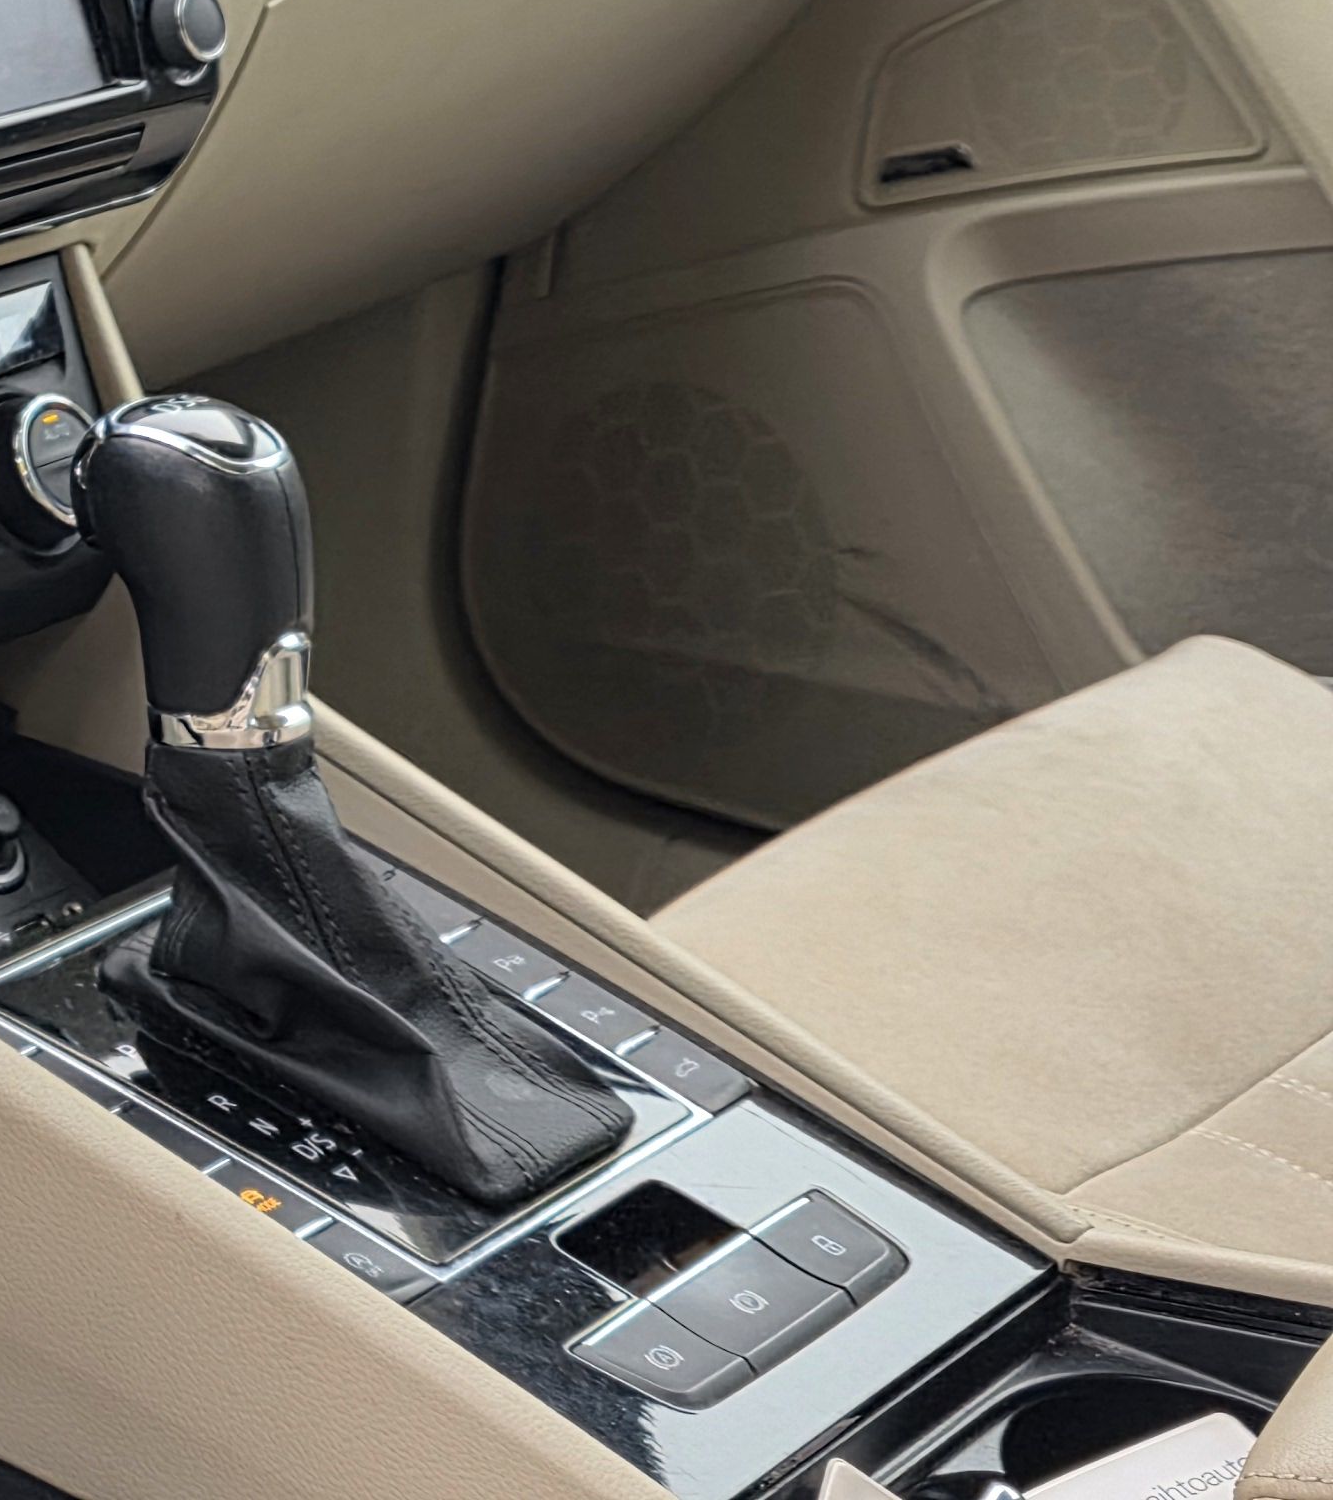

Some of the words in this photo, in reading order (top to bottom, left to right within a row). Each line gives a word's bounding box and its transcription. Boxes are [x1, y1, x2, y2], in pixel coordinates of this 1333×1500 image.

[206, 1093, 238, 1114] R
[247, 1116, 281, 1138] N
[291, 1132, 339, 1164] D/S
